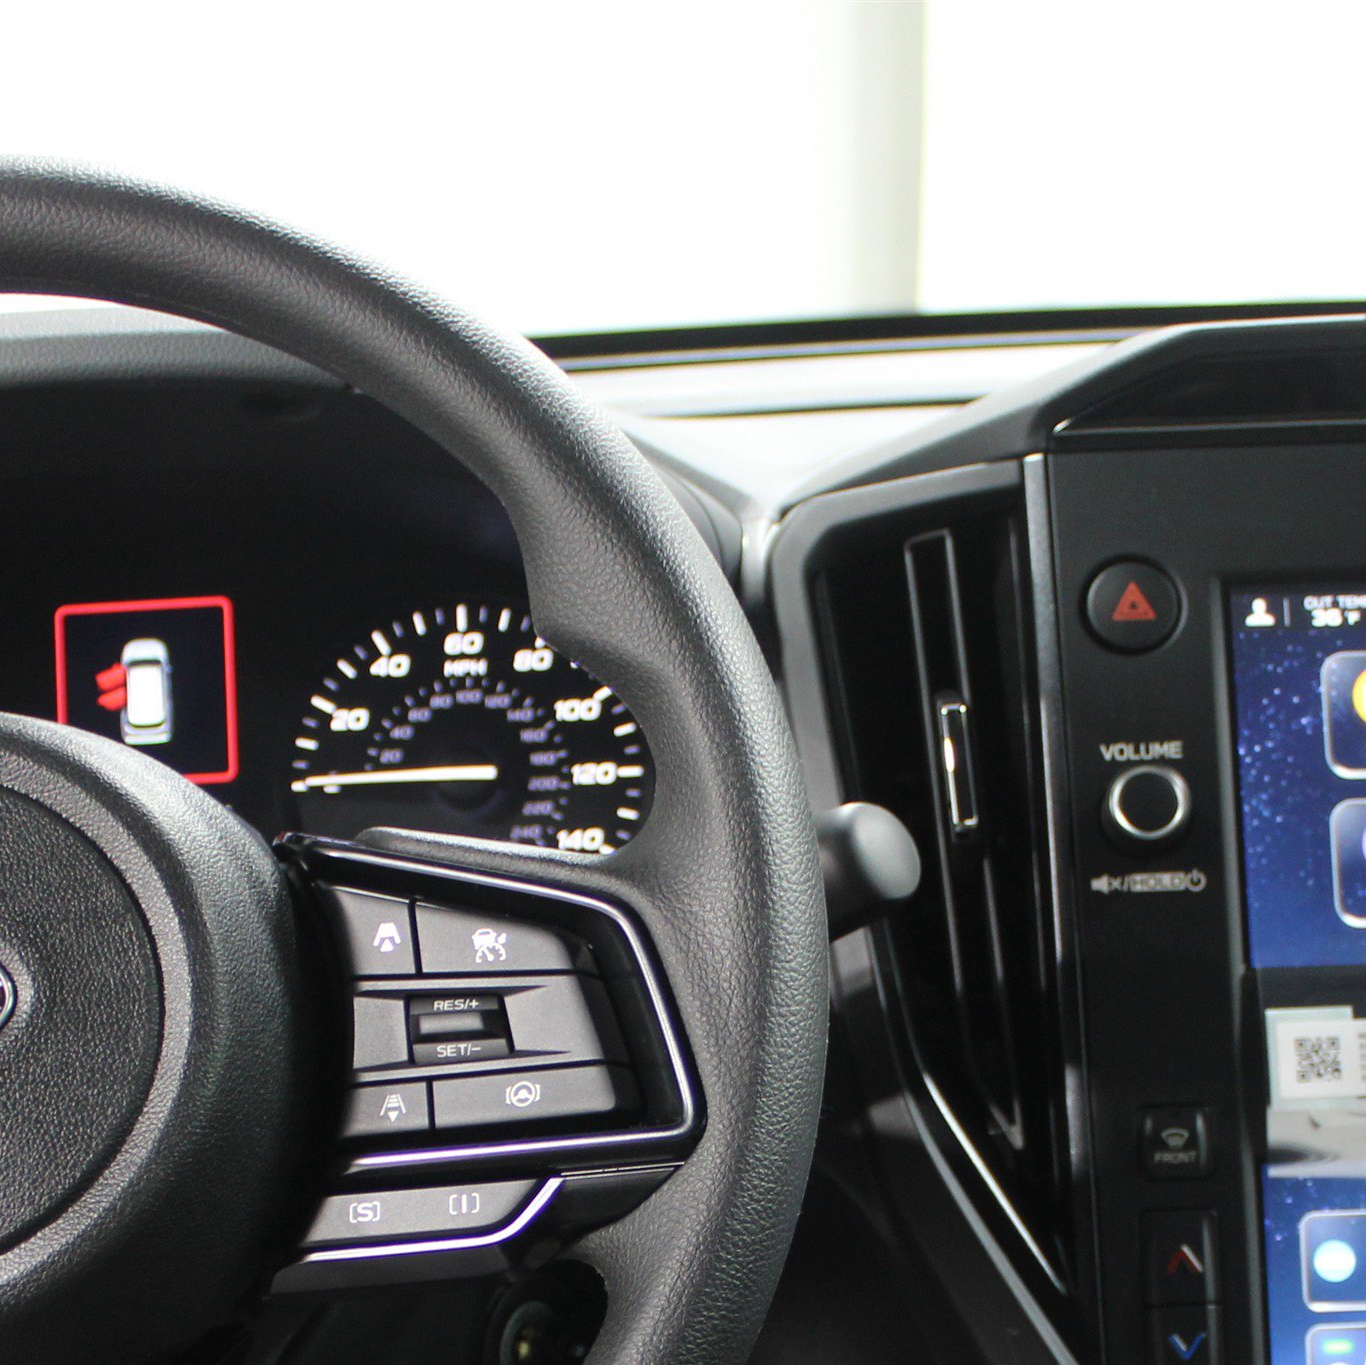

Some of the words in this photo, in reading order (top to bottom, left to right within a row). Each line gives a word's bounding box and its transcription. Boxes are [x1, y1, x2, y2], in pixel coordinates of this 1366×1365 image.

[443, 632, 484, 655] 60
[369, 654, 411, 678] 40
[443, 658, 488, 677] MPH
[513, 648, 553, 673] 80
[330, 708, 369, 732] 20
[554, 698, 602, 722] 100
[1099, 741, 1183, 762] VOLUME
[571, 761, 618, 785] 120
[557, 827, 605, 851] 140
